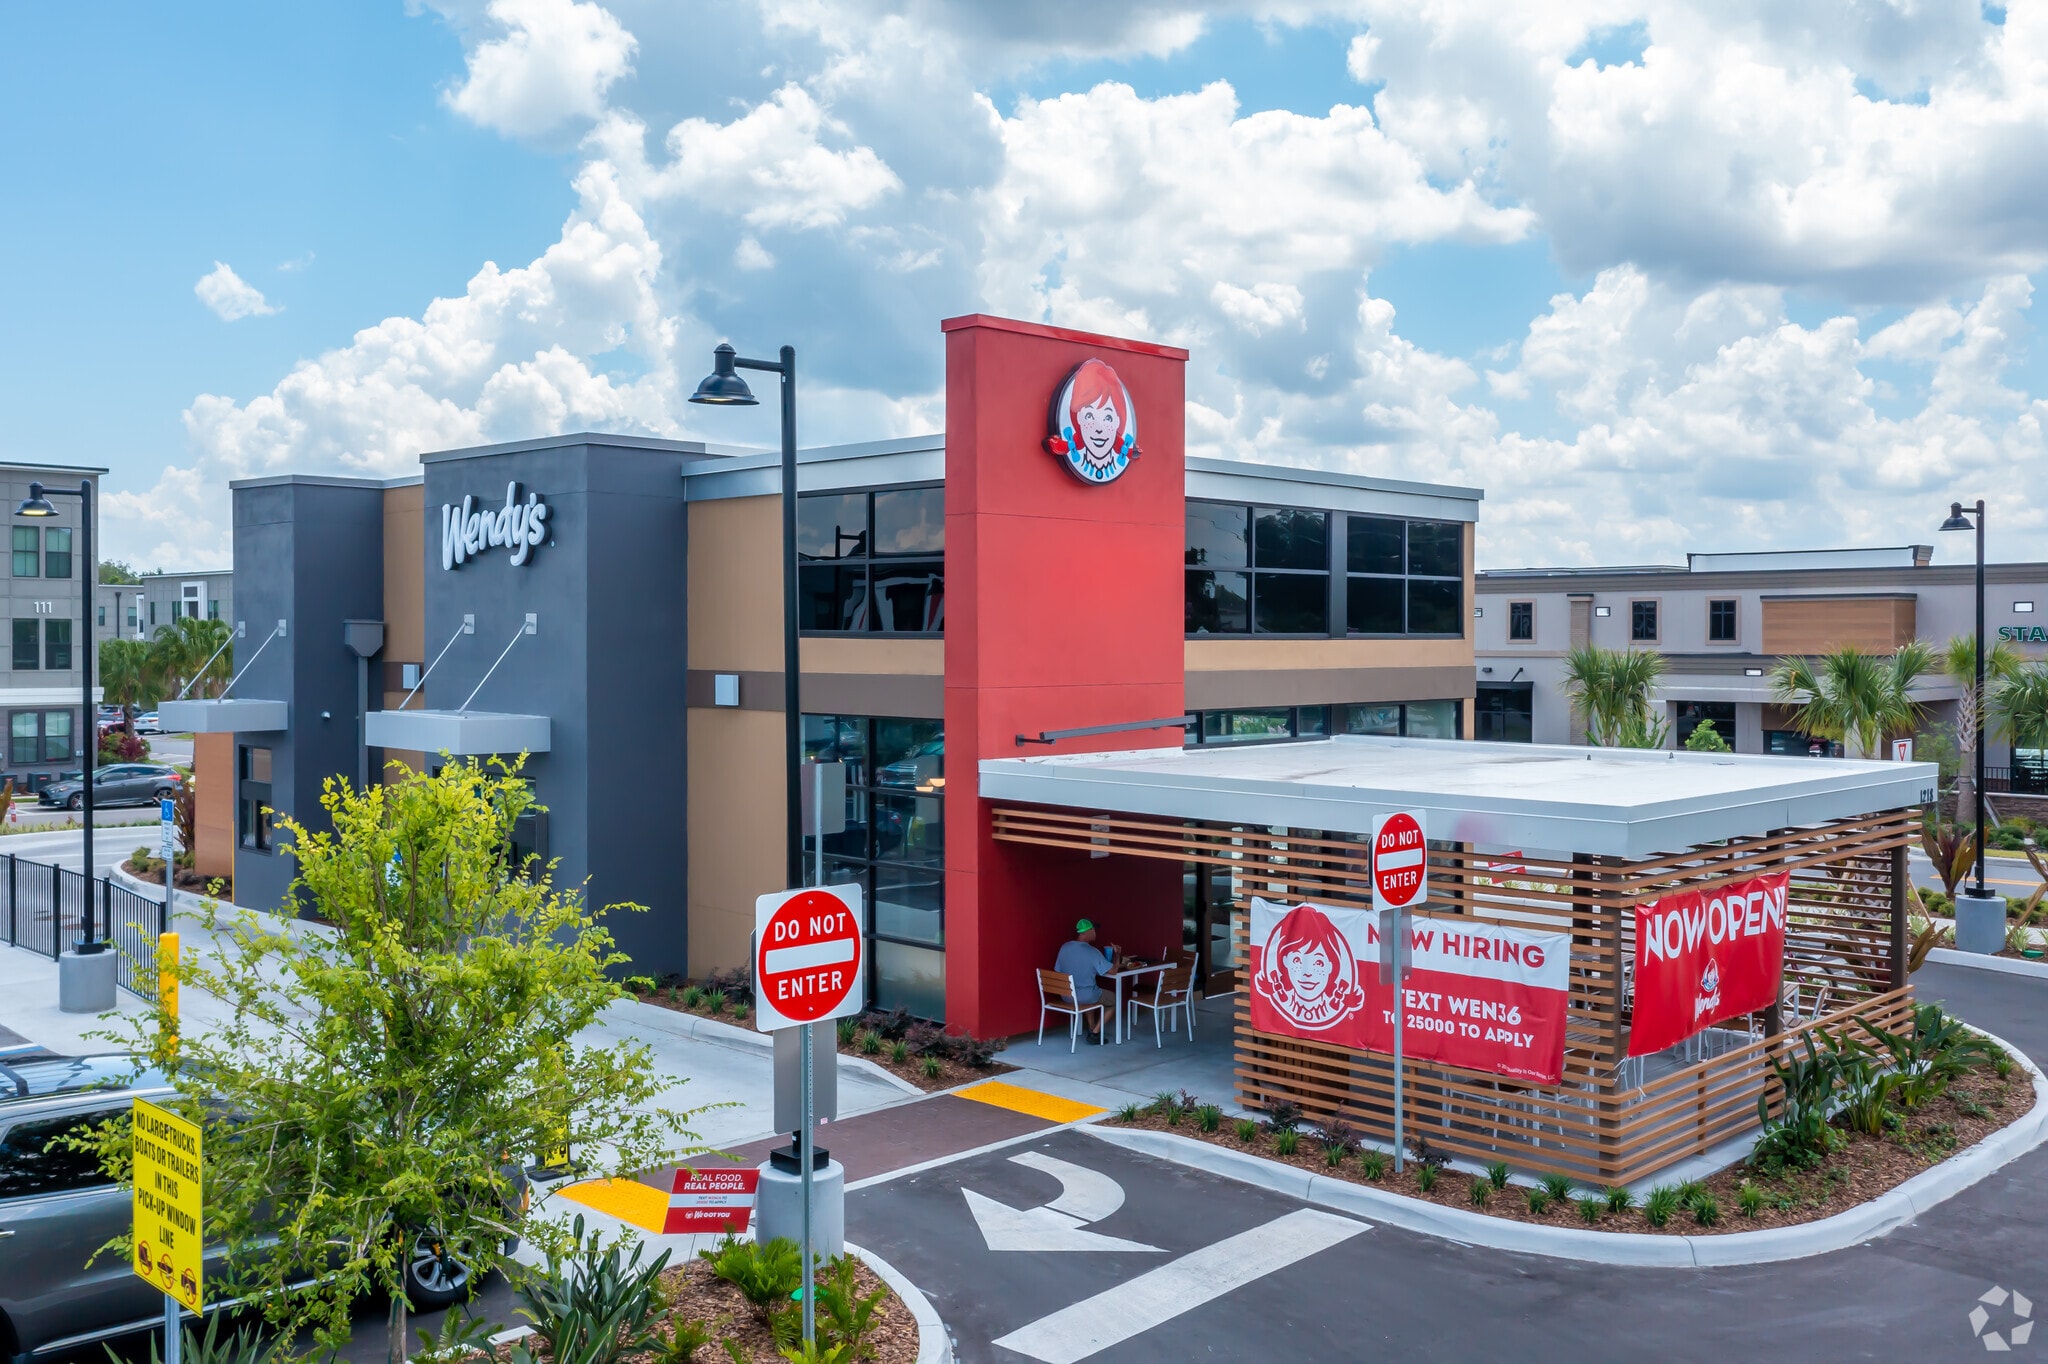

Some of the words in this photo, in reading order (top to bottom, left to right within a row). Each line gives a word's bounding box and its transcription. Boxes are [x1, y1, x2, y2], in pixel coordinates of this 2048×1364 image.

[442, 481, 547, 570] Wendy's
[34, 601, 52, 614] 111
[1920, 788, 1934, 803] 1218
[1381, 833, 1395, 849] DO
[1399, 830, 1419, 846] NOT
[1383, 871, 1417, 890] ENTER
[774, 919, 800, 942] DO
[809, 912, 846, 937] NOT
[1644, 902, 1706, 967] NOW
[1708, 885, 1786, 945] OPEN!
[1367, 923, 1434, 952] NW
[1442, 932, 1545, 969] HIRING
[778, 970, 842, 1000] ENTER
[1401, 988, 1442, 1012] EXT
[1447, 995, 1522, 1026] WEN36
[1407, 1014, 1455, 1034] 25000
[1459, 1022, 1481, 1039] TO
[1484, 1027, 1535, 1048] APPLY
[136, 1111, 145, 1129] NO
[146, 1115, 168, 1140] LARGE
[168, 1126, 198, 1160] TRUCKS,
[135, 1135, 156, 1162] BOATS
[156, 1146, 166, 1166] OR
[167, 1151, 199, 1185] TRAILERS
[154, 1171, 162, 1191] IN
[163, 1175, 179, 1200] THIS
[684, 1182, 707, 1190] REAL
[708, 1182, 745, 1190] PEOPLE.
[715, 1174, 743, 1182] FOOD.
[138, 1187, 166, 1218] PICK-UP
[166, 1201, 196, 1236] WINDOW
[159, 1225, 174, 1250] LINE
